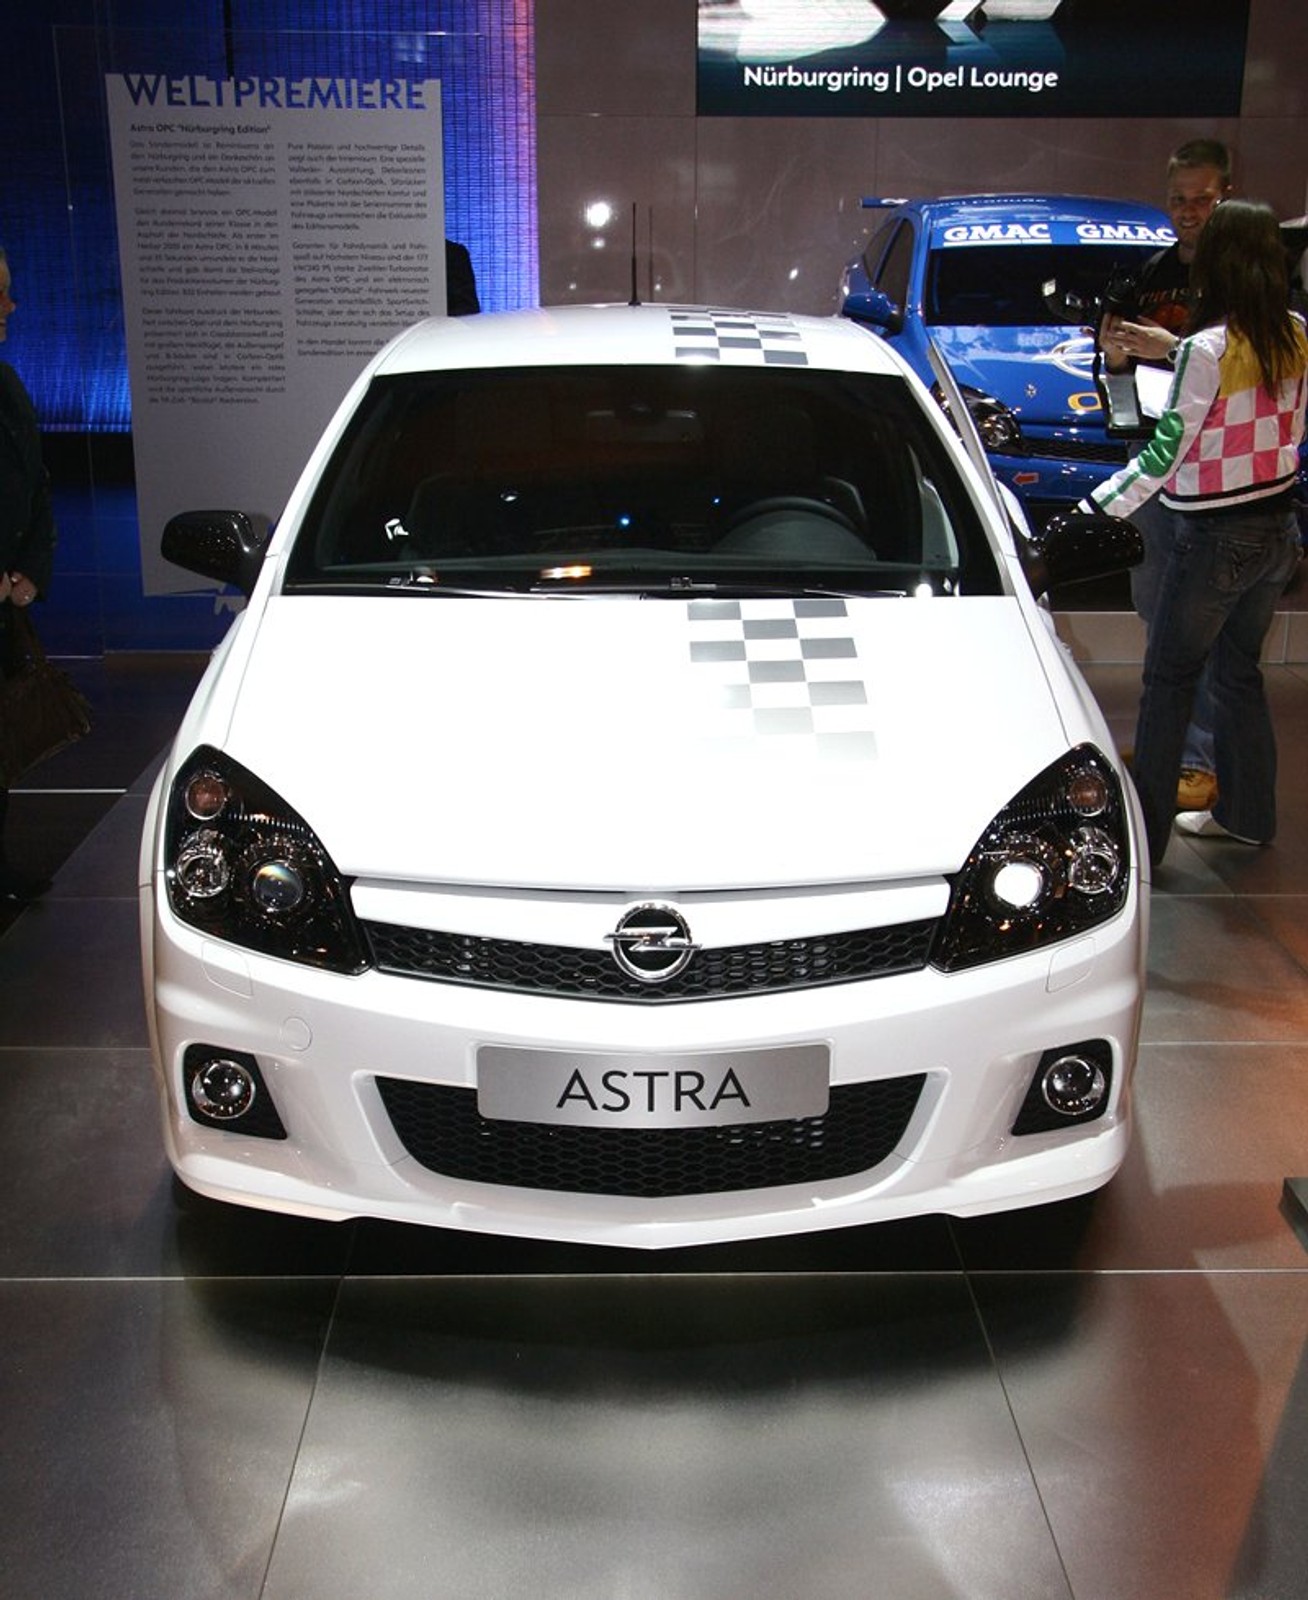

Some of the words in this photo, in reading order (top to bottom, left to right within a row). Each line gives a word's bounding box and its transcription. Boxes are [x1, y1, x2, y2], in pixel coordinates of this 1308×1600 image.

[123, 74, 427, 110] WELTPREMIERE
[743, 66, 890, 93] Nürburgring
[906, 67, 964, 92] Opel
[970, 67, 1059, 93] Lounge
[156, 123, 176, 133] OPC
[943, 223, 1051, 241] GMAC
[1076, 223, 1178, 242] GMAC
[556, 1067, 751, 1113] ASTRA
